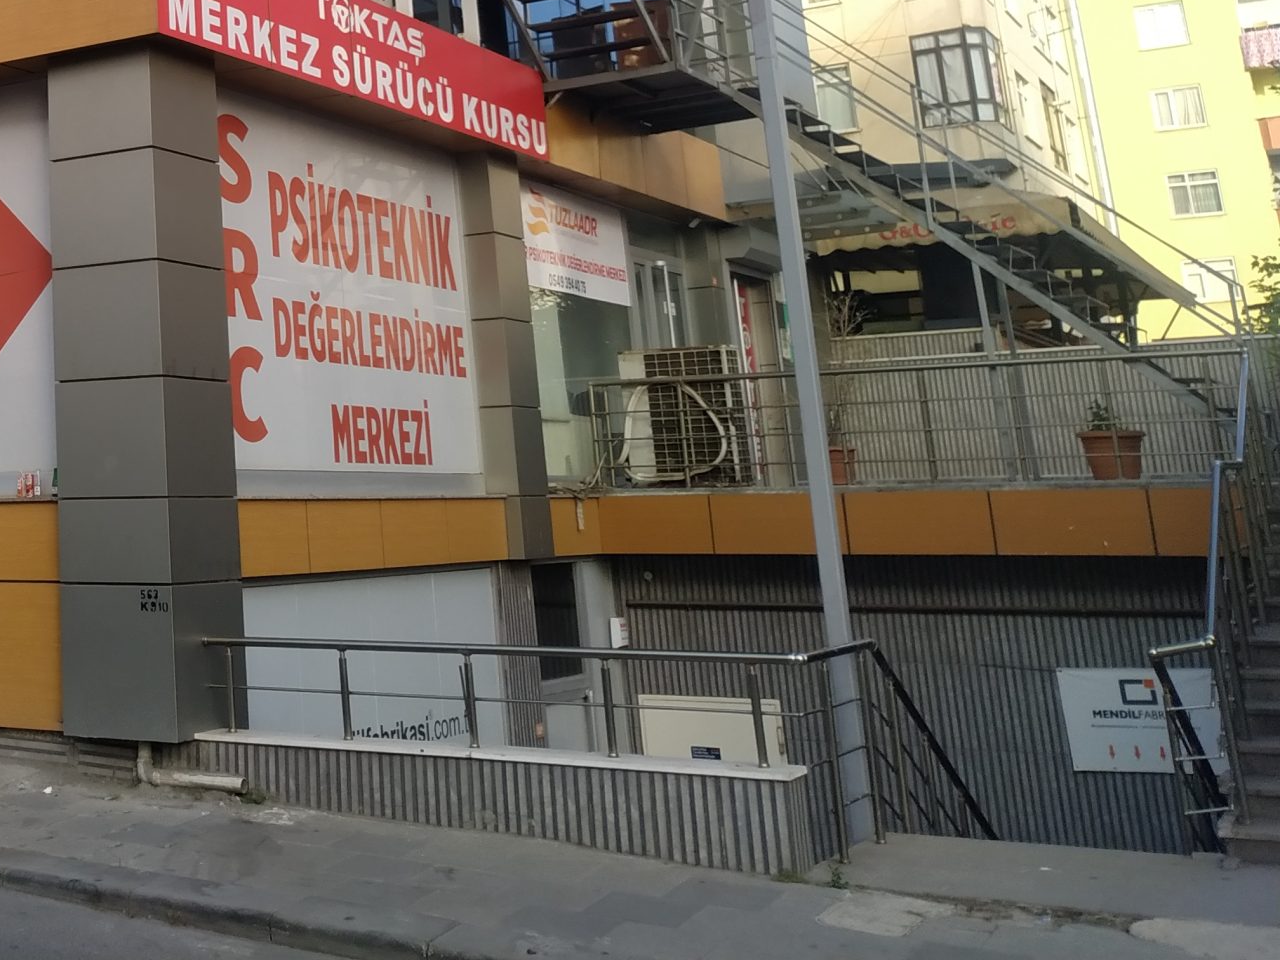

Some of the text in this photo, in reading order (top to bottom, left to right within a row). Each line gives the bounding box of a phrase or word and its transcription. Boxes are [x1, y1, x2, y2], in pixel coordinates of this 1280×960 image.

[331, 43, 455, 124] SÜRÜCÜ
[462, 91, 548, 156] KURSU
[267, 162, 458, 292] PSİKOTEKNİK
[272, 291, 467, 379] DEĞERLENDİRME
[331, 399, 433, 466] MERKEZİ
